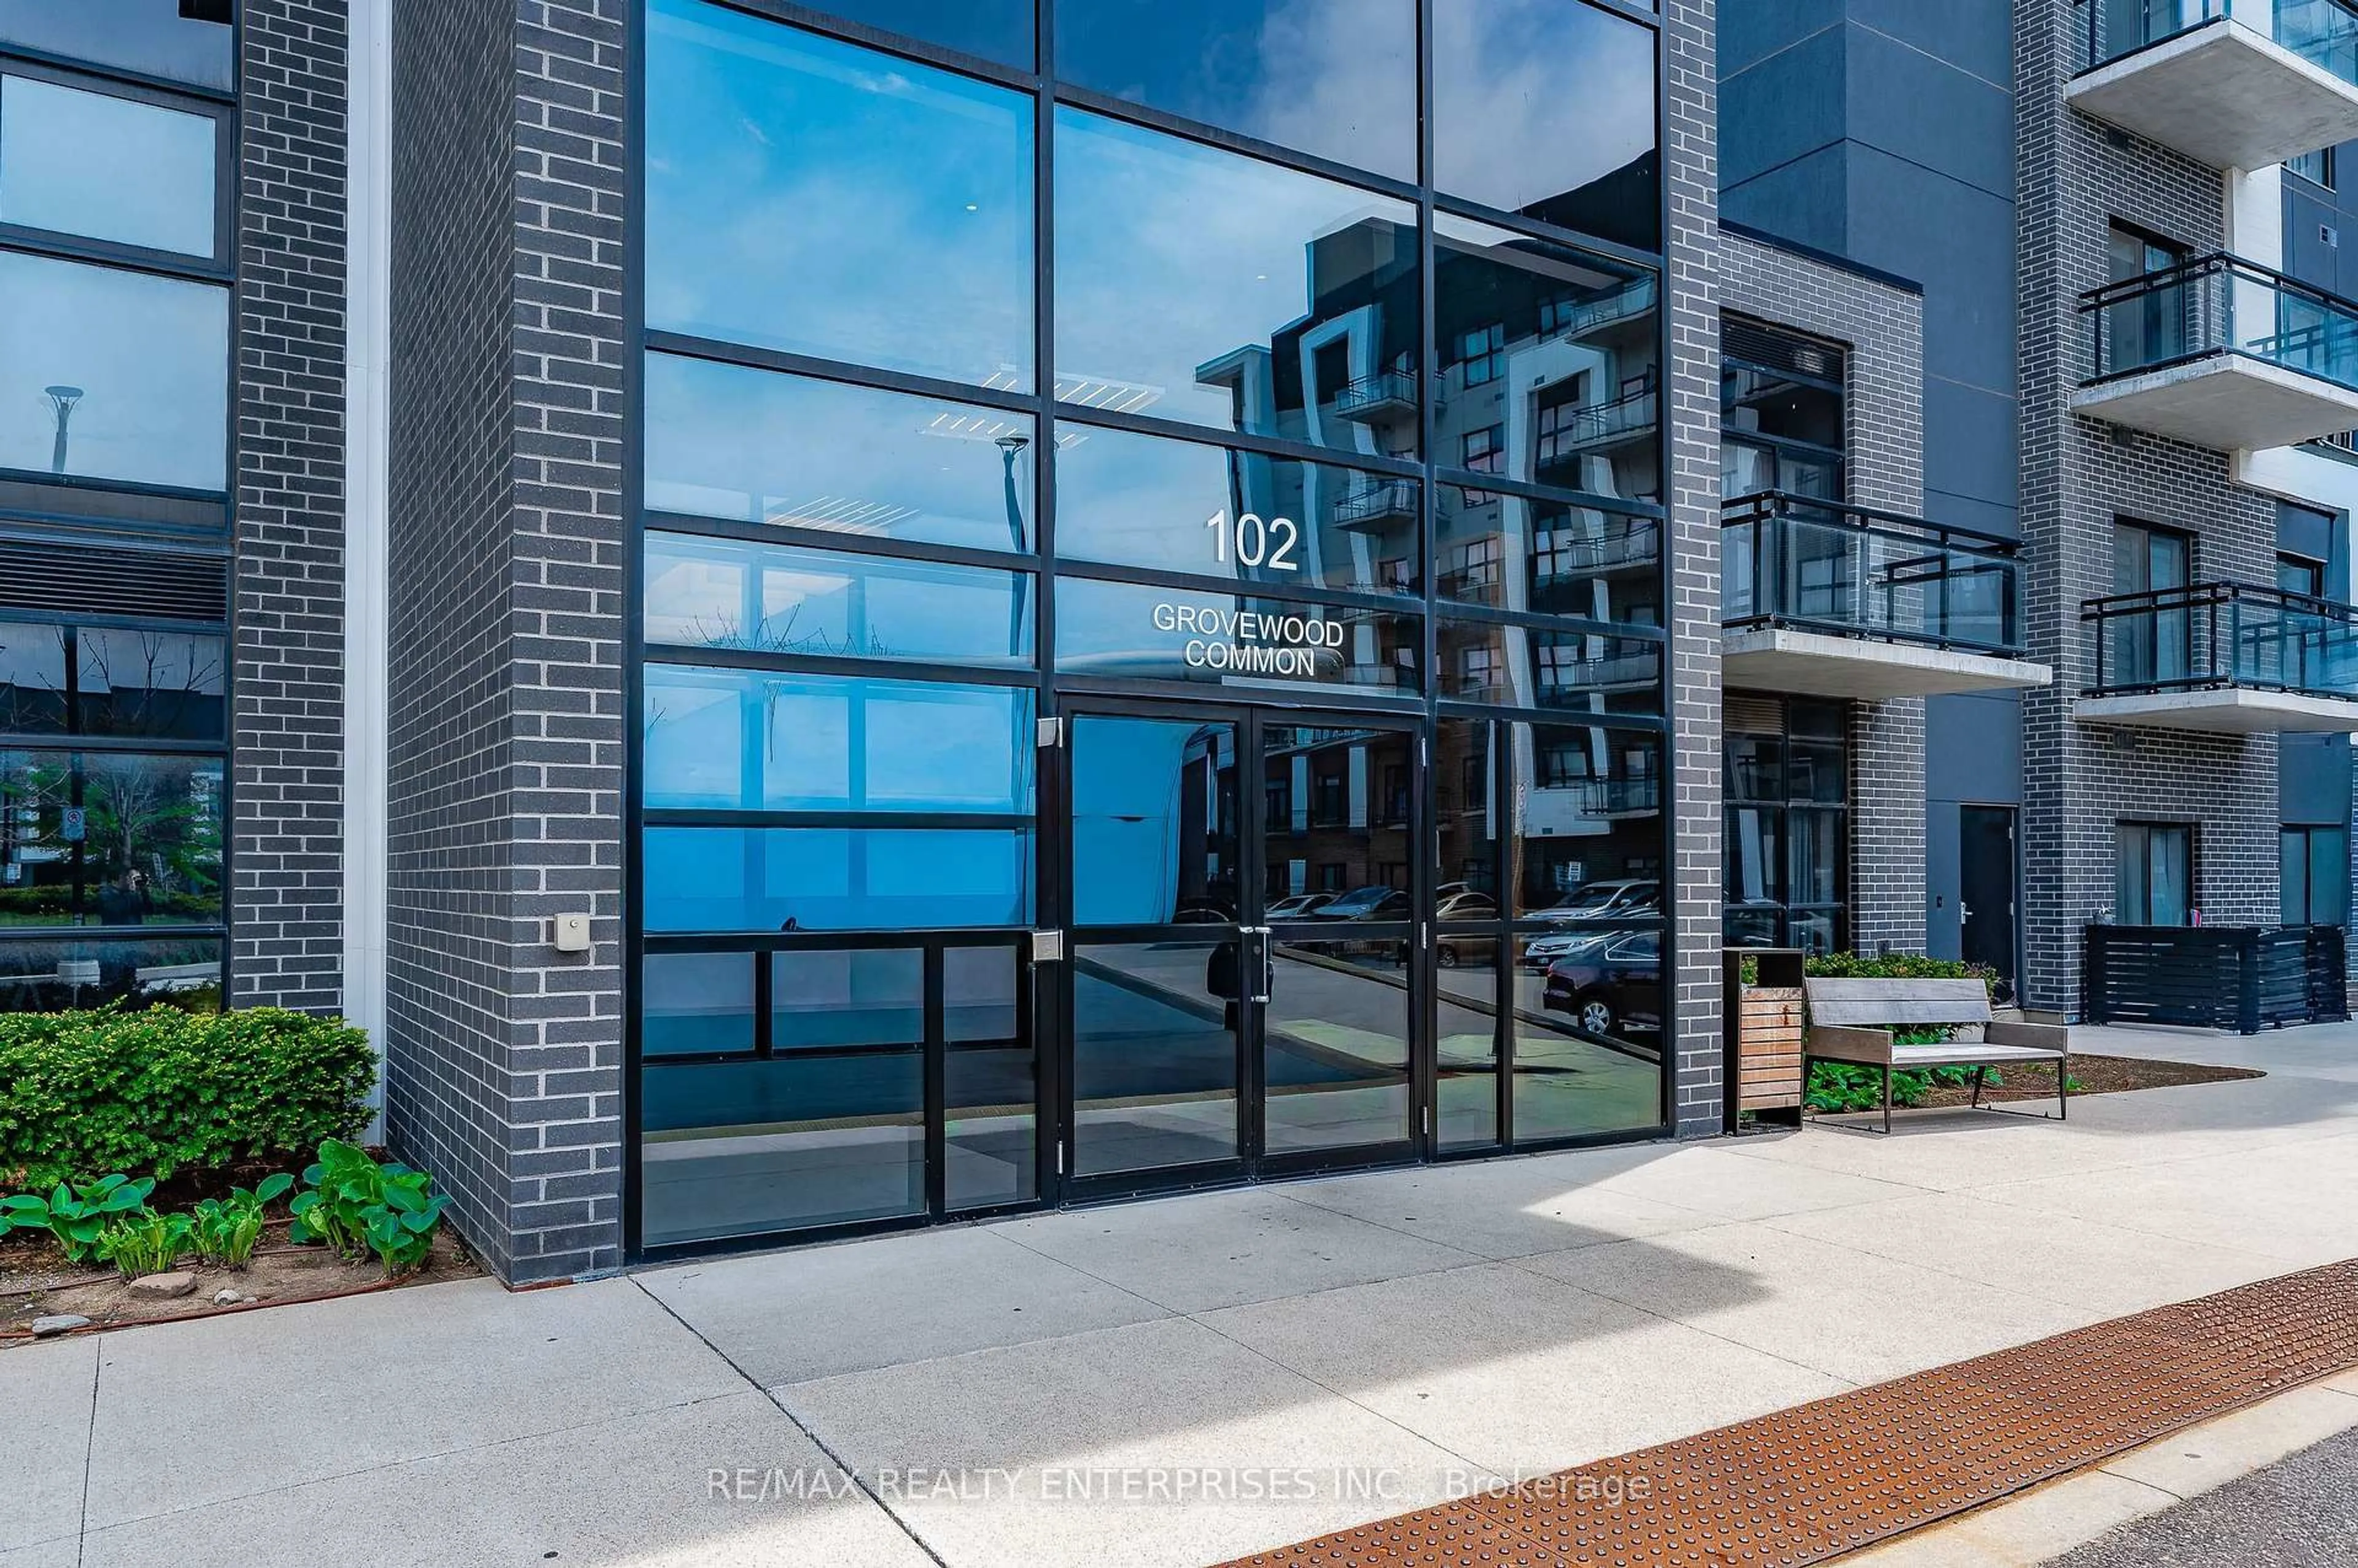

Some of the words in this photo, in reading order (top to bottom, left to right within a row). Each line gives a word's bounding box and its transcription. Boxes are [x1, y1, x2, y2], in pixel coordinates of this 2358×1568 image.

[1206, 509, 1298, 571] 102
[1153, 604, 1344, 647] GROVEWOOD
[1185, 640, 1315, 676] COMMON
